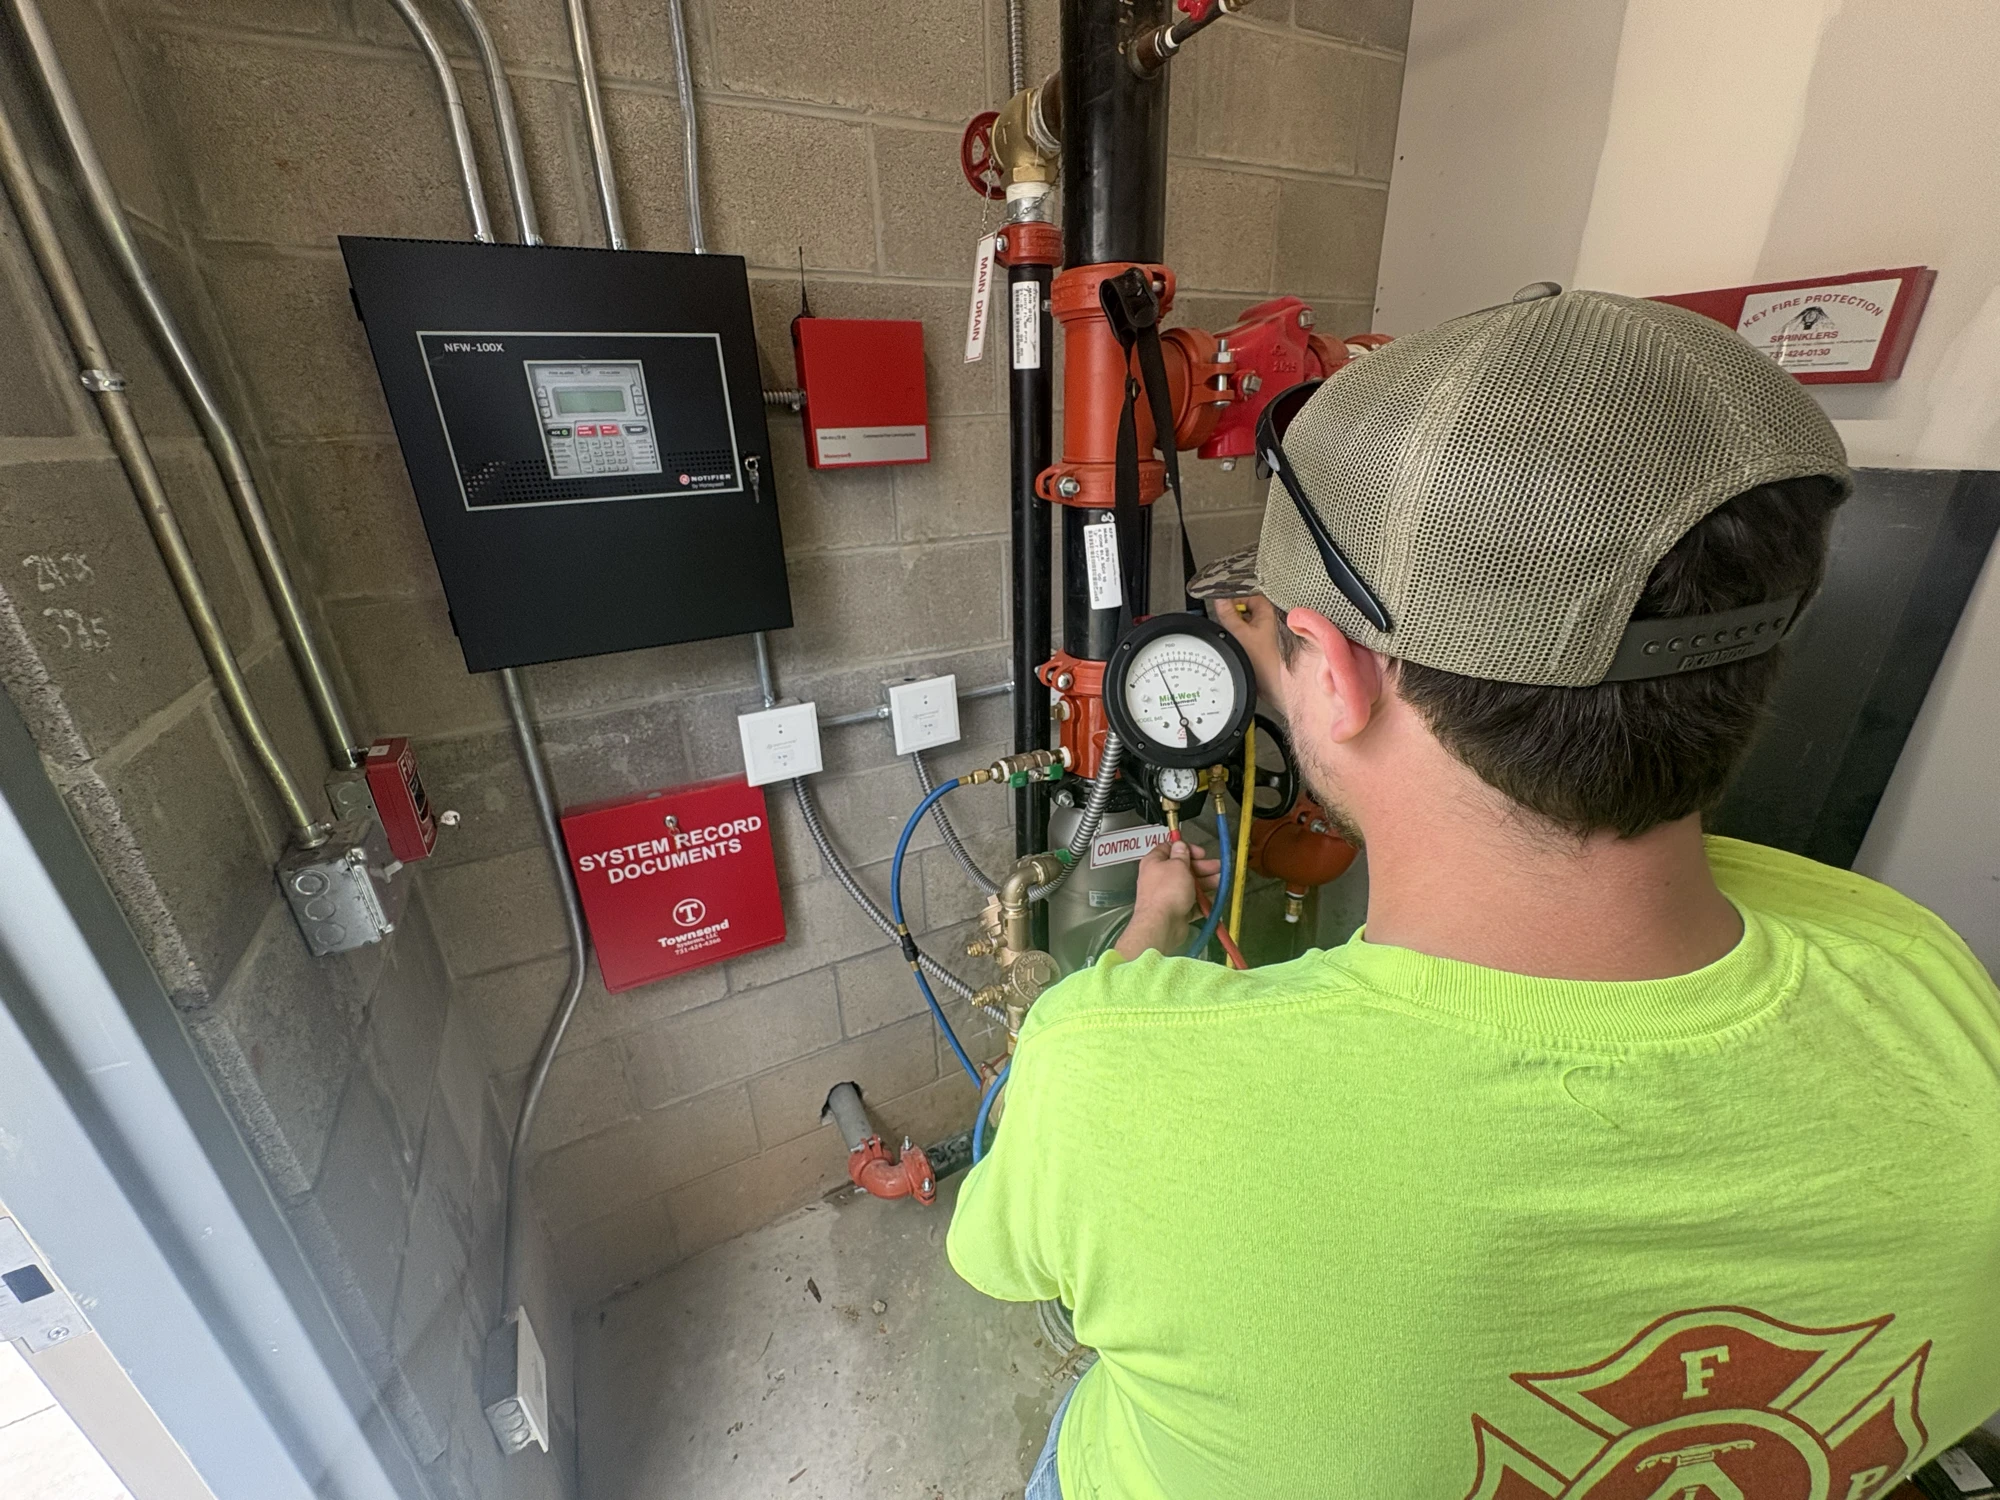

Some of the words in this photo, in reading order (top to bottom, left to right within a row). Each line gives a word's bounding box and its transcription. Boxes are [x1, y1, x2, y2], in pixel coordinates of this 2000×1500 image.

[978, 257, 988, 293] MAIN
[972, 300, 983, 341] DRAIN
[1743, 308, 1768, 328] KEY
[1771, 297, 1801, 313] FIRE
[1804, 294, 1883, 317] PROTECTION
[443, 342, 505, 354] NFW-100X
[1770, 330, 1839, 343] SPRINKLERS
[691, 474, 731, 482] NOTIFIER
[579, 836, 670, 872] SYSTEM
[674, 815, 762, 849] RECORD
[1098, 837, 1141, 856] CONTROL
[1145, 832, 1171, 847] VALV
[607, 838, 742, 884] DOCUMENTS
[657, 919, 730, 948] Townsend
[705, 931, 718, 940] LLC
[1680, 1344, 1730, 1400] F
